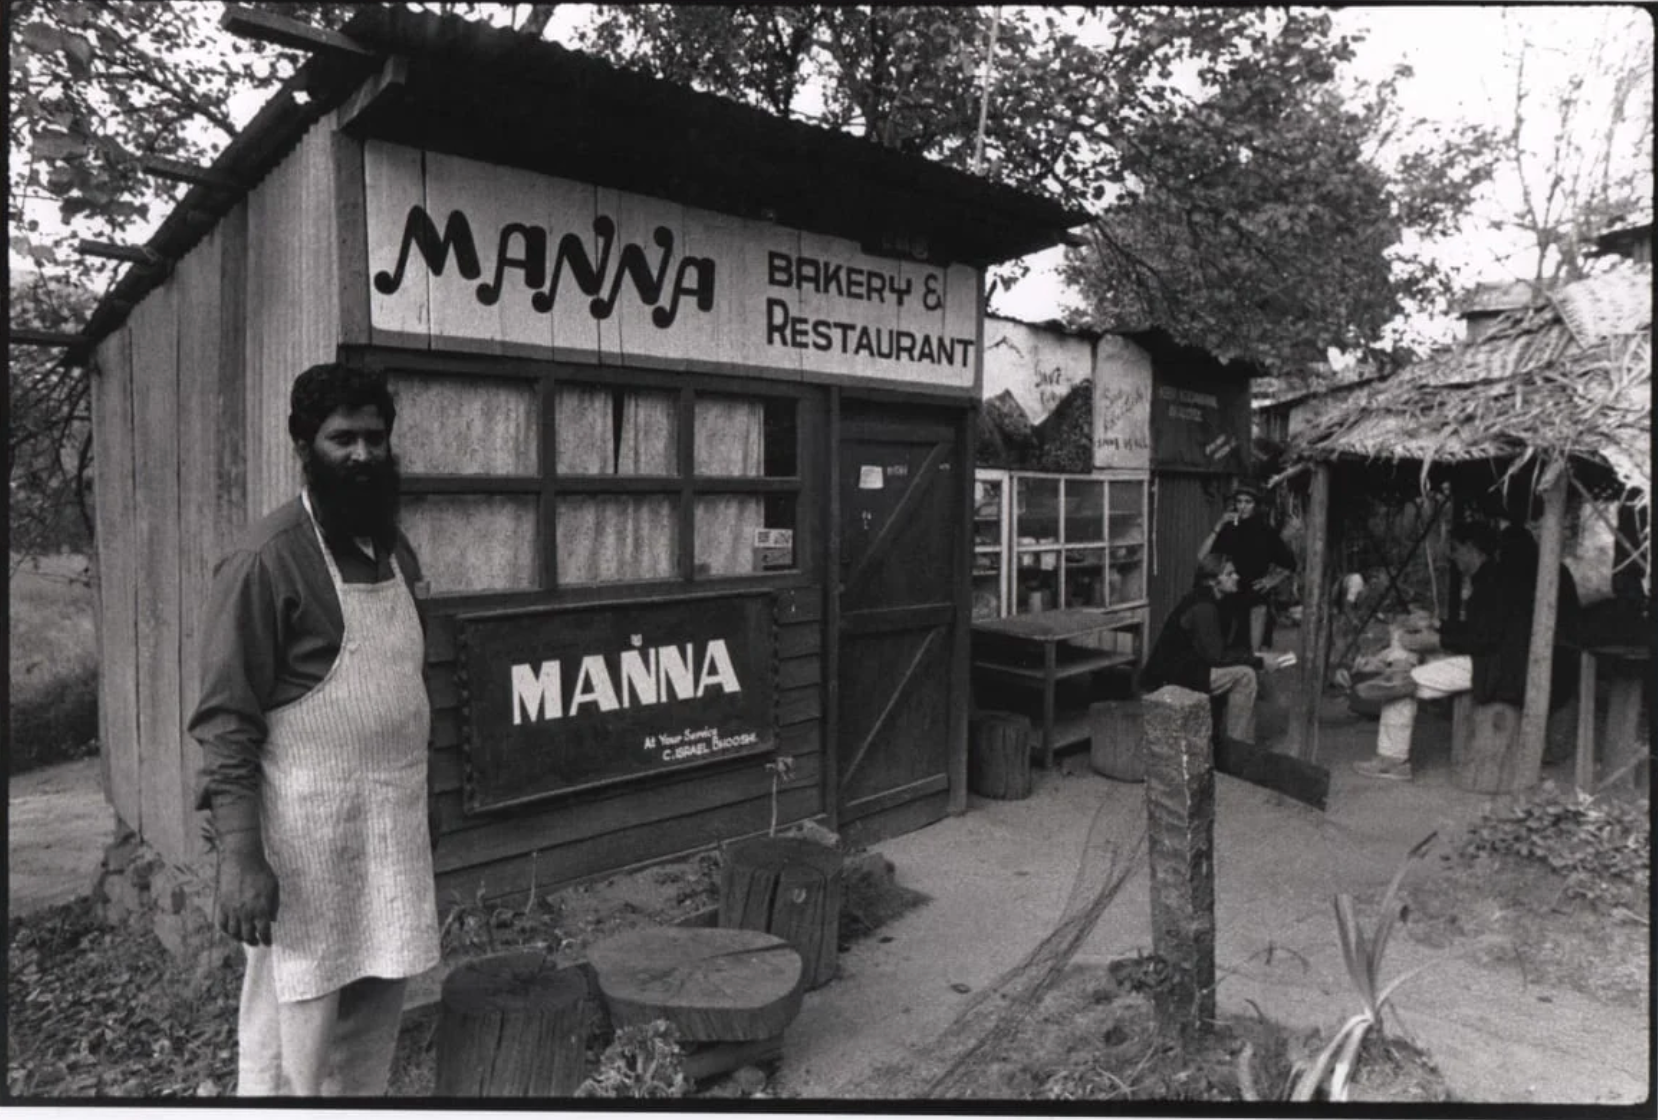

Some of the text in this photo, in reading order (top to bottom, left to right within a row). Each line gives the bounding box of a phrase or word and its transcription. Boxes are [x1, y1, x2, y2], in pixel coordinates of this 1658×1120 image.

[374, 205, 715, 328] MANNA
[768, 250, 942, 310] BAKERY &
[766, 297, 975, 367] RESTAURANT
[510, 638, 742, 725] MANNA
[643, 726, 718, 750] At Your Service
